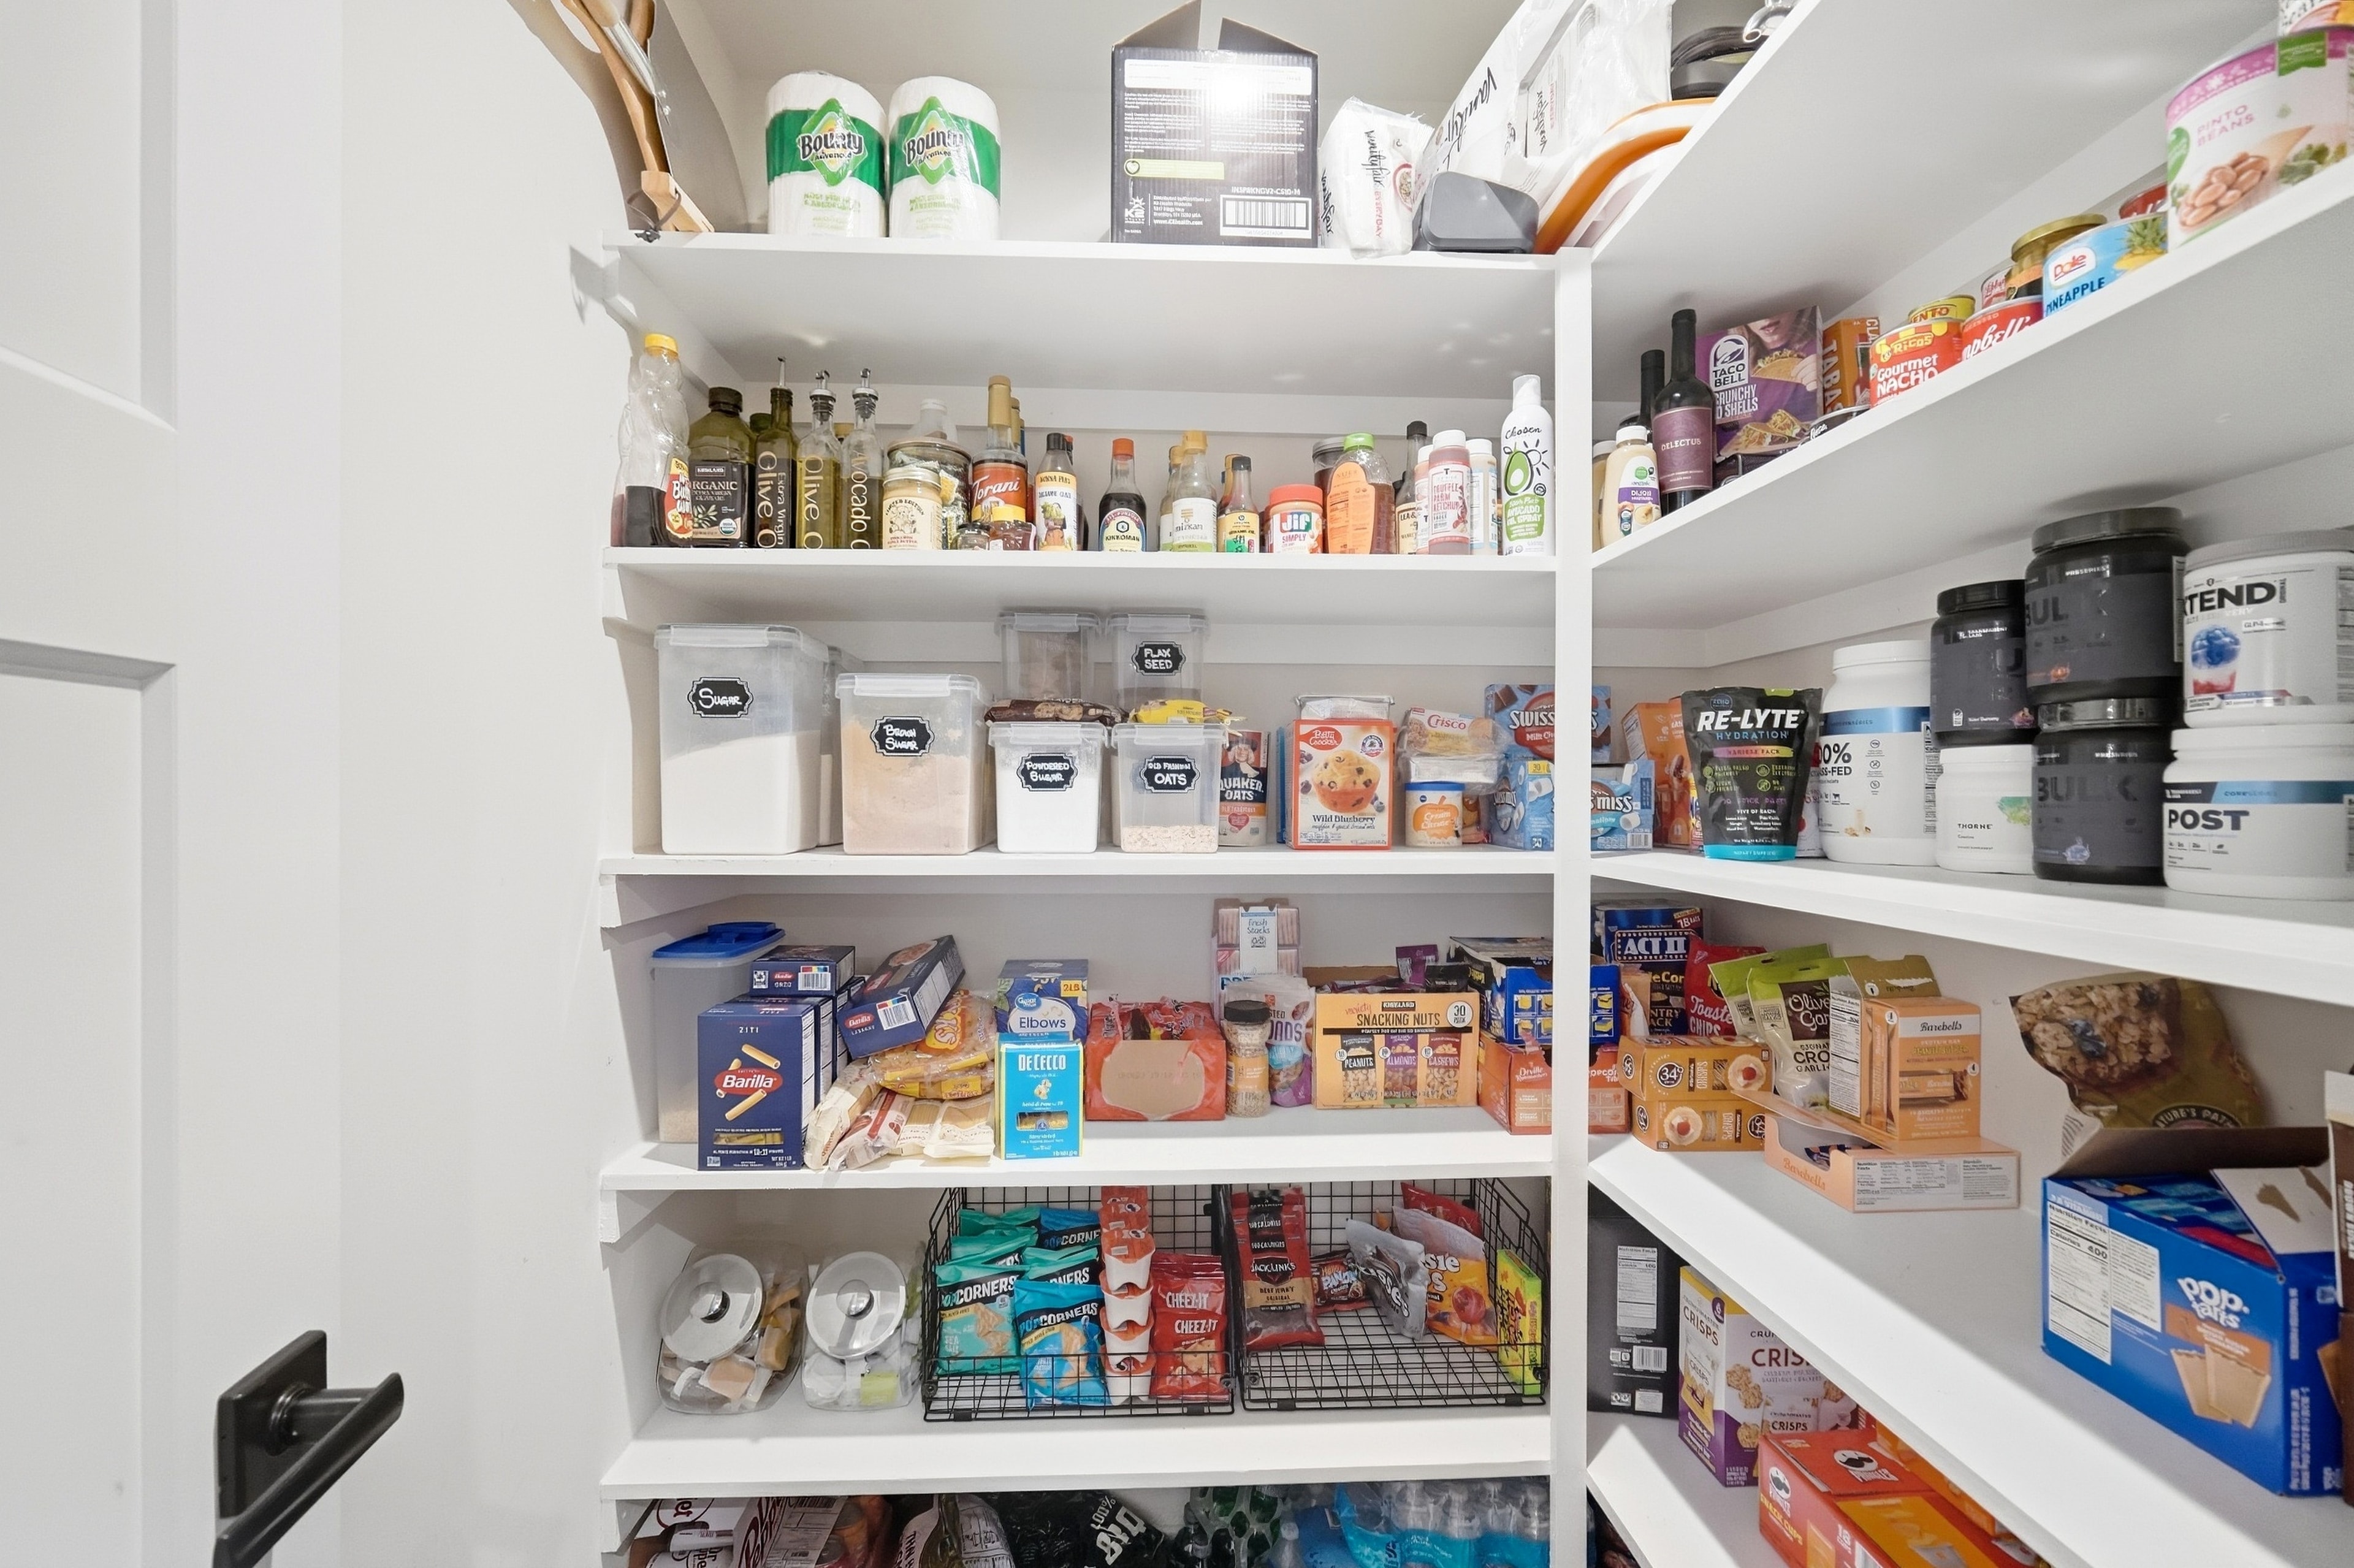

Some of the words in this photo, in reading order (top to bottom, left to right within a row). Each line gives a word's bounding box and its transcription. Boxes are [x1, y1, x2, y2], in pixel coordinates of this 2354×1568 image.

[2196, 104, 2249, 134] PINTO
[2197, 114, 2255, 147] BEANS
[800, 133, 863, 161] Bounty
[905, 130, 964, 166] Bounty
[2052, 253, 2087, 280] Dole
[1713, 365, 1746, 378] TACO
[1876, 353, 1938, 382] Gourmet
[1714, 373, 1746, 388] BELL
[1876, 369, 1938, 398] NACHO
[1726, 397, 1759, 417] SHELLS
[1505, 426, 1542, 440] Chosen
[1661, 438, 1702, 451] DELECTUS
[758, 452, 777, 520] Olive
[777, 473, 786, 504] Extra
[804, 455, 824, 522] Olive
[850, 451, 872, 532] Avocado
[972, 474, 1020, 506] Torani
[1433, 501, 1460, 512] KETCHUP
[1282, 513, 1311, 531] Jif
[1400, 512, 1410, 522] LEA
[777, 509, 786, 545] Virgin
[1282, 534, 1306, 543] SIMPLY
[1144, 648, 1171, 658] FLAX
[1145, 659, 1173, 670] SEED
[1427, 714, 1466, 731] Crisco
[1509, 710, 1555, 729] SWISS
[1697, 709, 1800, 732] RE-LYTE
[1309, 737, 1339, 746] Crocker
[1312, 729, 1335, 739] Betty
[1716, 730, 1788, 740] HYDRATION
[1025, 760, 1070, 771] POWDERED
[1154, 773, 1187, 786] OATS
[1220, 777, 1263, 793] QUAKER
[1225, 790, 1254, 801] OATS
[1312, 814, 1333, 823] Wild
[1334, 814, 1376, 824] Blueberry
[2168, 809, 2250, 831] POST
[1247, 926, 1270, 935] Stacks
[1624, 937, 1661, 956] ACT
[1665, 937, 1687, 954] II
[1661, 971, 1685, 983] Cor
[1344, 1002, 1373, 1015] variety
[1690, 995, 1734, 1023] Toaste
[1788, 993, 1831, 1012] Olive
[1453, 1005, 1466, 1017] 30
[848, 1014, 871, 1027] Barilla
[1019, 1017, 1066, 1029] Elbows
[1356, 1013, 1409, 1027] SNACKING
[1413, 1013, 1441, 1026] NUTS
[1689, 1017, 1721, 1036] CHIPS
[1919, 1021, 1962, 1032] Barebells
[1018, 1054, 1032, 1071] DE
[1034, 1054, 1066, 1071] CECCO
[1344, 1057, 1374, 1068] PEANUTS
[1386, 1056, 1417, 1066] ALMONDS
[1428, 1056, 1459, 1067] CASHEWS
[1519, 1065, 1544, 1076] Orville
[1696, 1060, 1708, 1089] CRISPS
[722, 1074, 775, 1089] Barilla
[1781, 1157, 1827, 1191] Barebells
[1683, 1305, 1719, 1346] CRISPS
[1771, 1420, 1808, 1432] CRISPS
[1091, 1496, 1116, 1530] 100%
